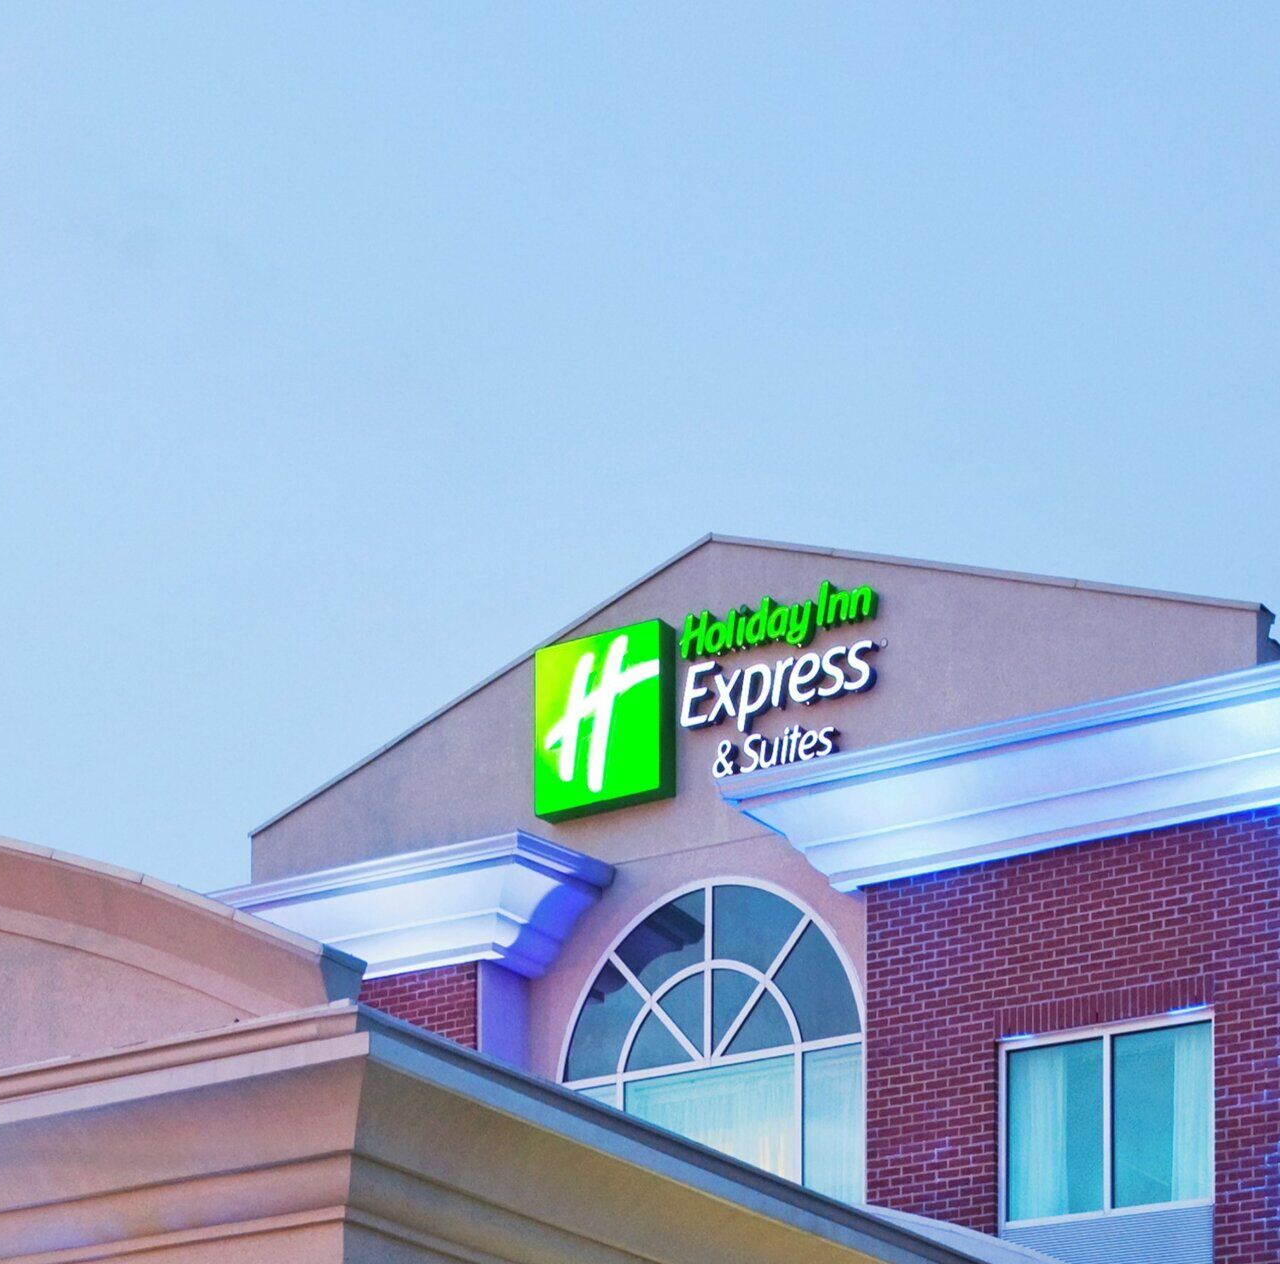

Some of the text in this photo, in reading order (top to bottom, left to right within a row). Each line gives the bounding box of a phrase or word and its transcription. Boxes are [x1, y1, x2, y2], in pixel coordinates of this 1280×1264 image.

[679, 580, 874, 660] Holiday Inn
[680, 639, 873, 732] Express
[712, 724, 835, 778] & Suites
